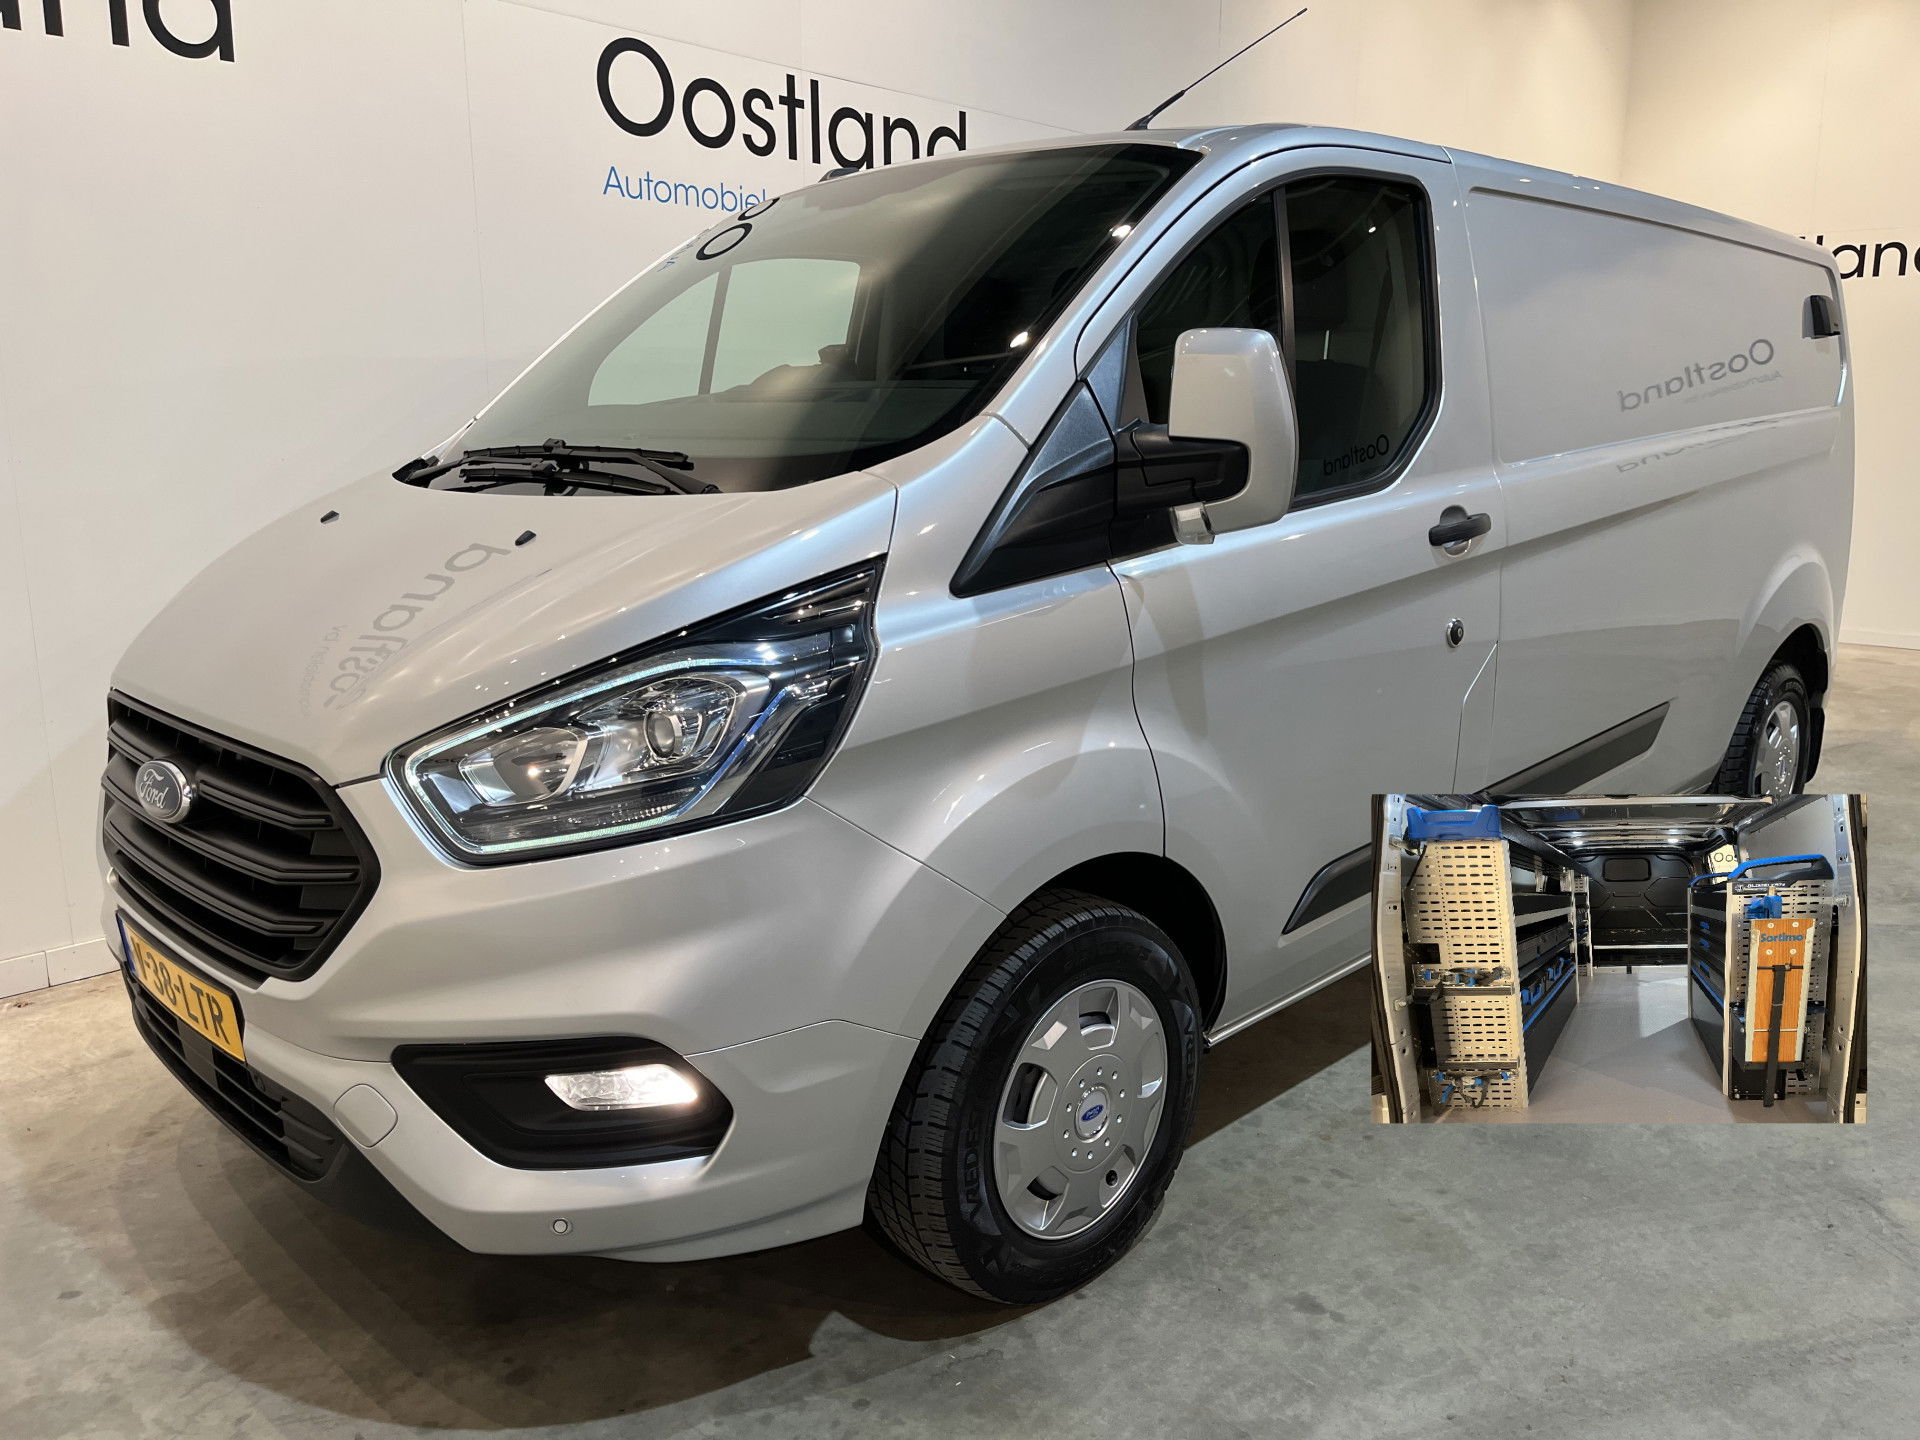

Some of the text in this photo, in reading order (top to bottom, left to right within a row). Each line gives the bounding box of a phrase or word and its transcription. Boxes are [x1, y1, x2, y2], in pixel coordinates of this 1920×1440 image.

[140, 768, 169, 809] Ford
[1760, 932, 1804, 943] Sortimo
[130, 935, 231, 1046] V-38-LTR
